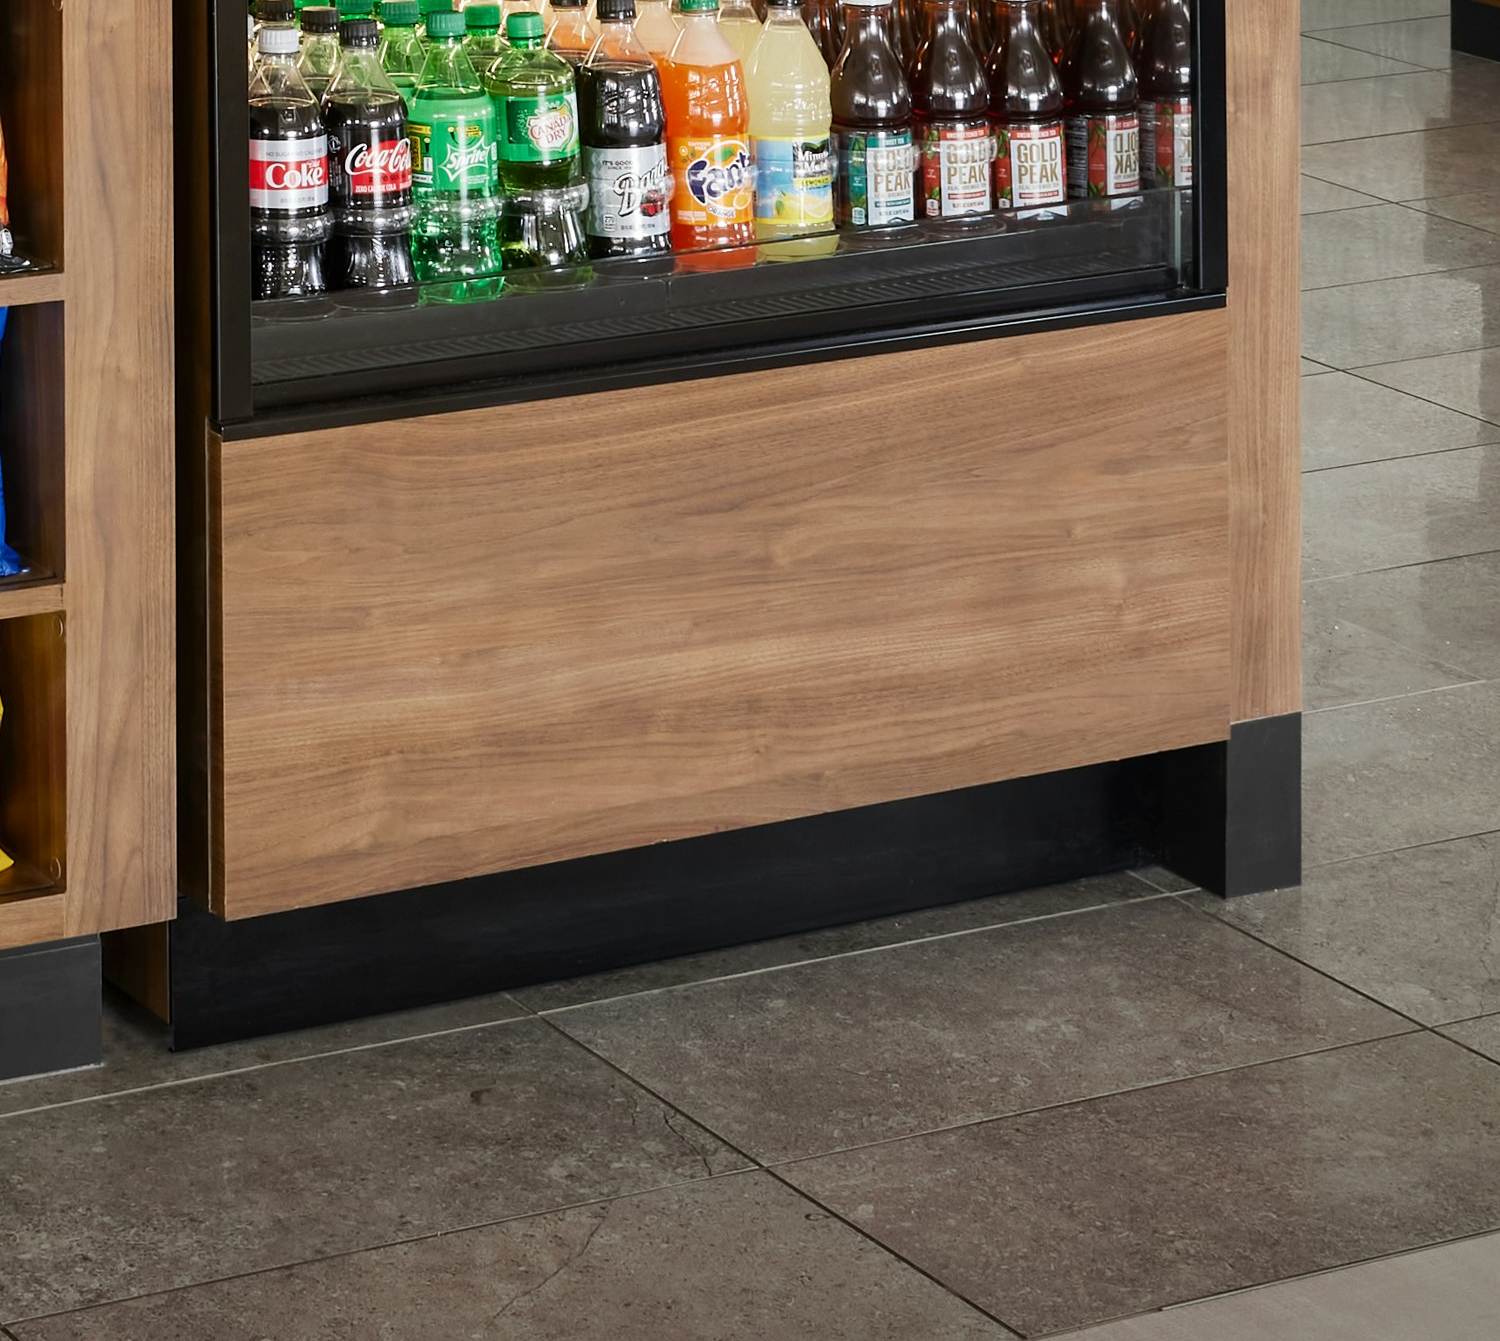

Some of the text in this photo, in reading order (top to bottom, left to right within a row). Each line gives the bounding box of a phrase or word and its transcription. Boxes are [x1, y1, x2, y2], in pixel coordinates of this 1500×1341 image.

[546, 129, 566, 144] DRY
[449, 148, 487, 169] Sprite
[947, 143, 986, 164] GOLD
[1017, 142, 1057, 164] GOLD
[266, 163, 323, 189] Coke
[874, 171, 910, 192] PEAK
[948, 169, 986, 185] PEAK
[1018, 164, 1059, 184] PEAK
